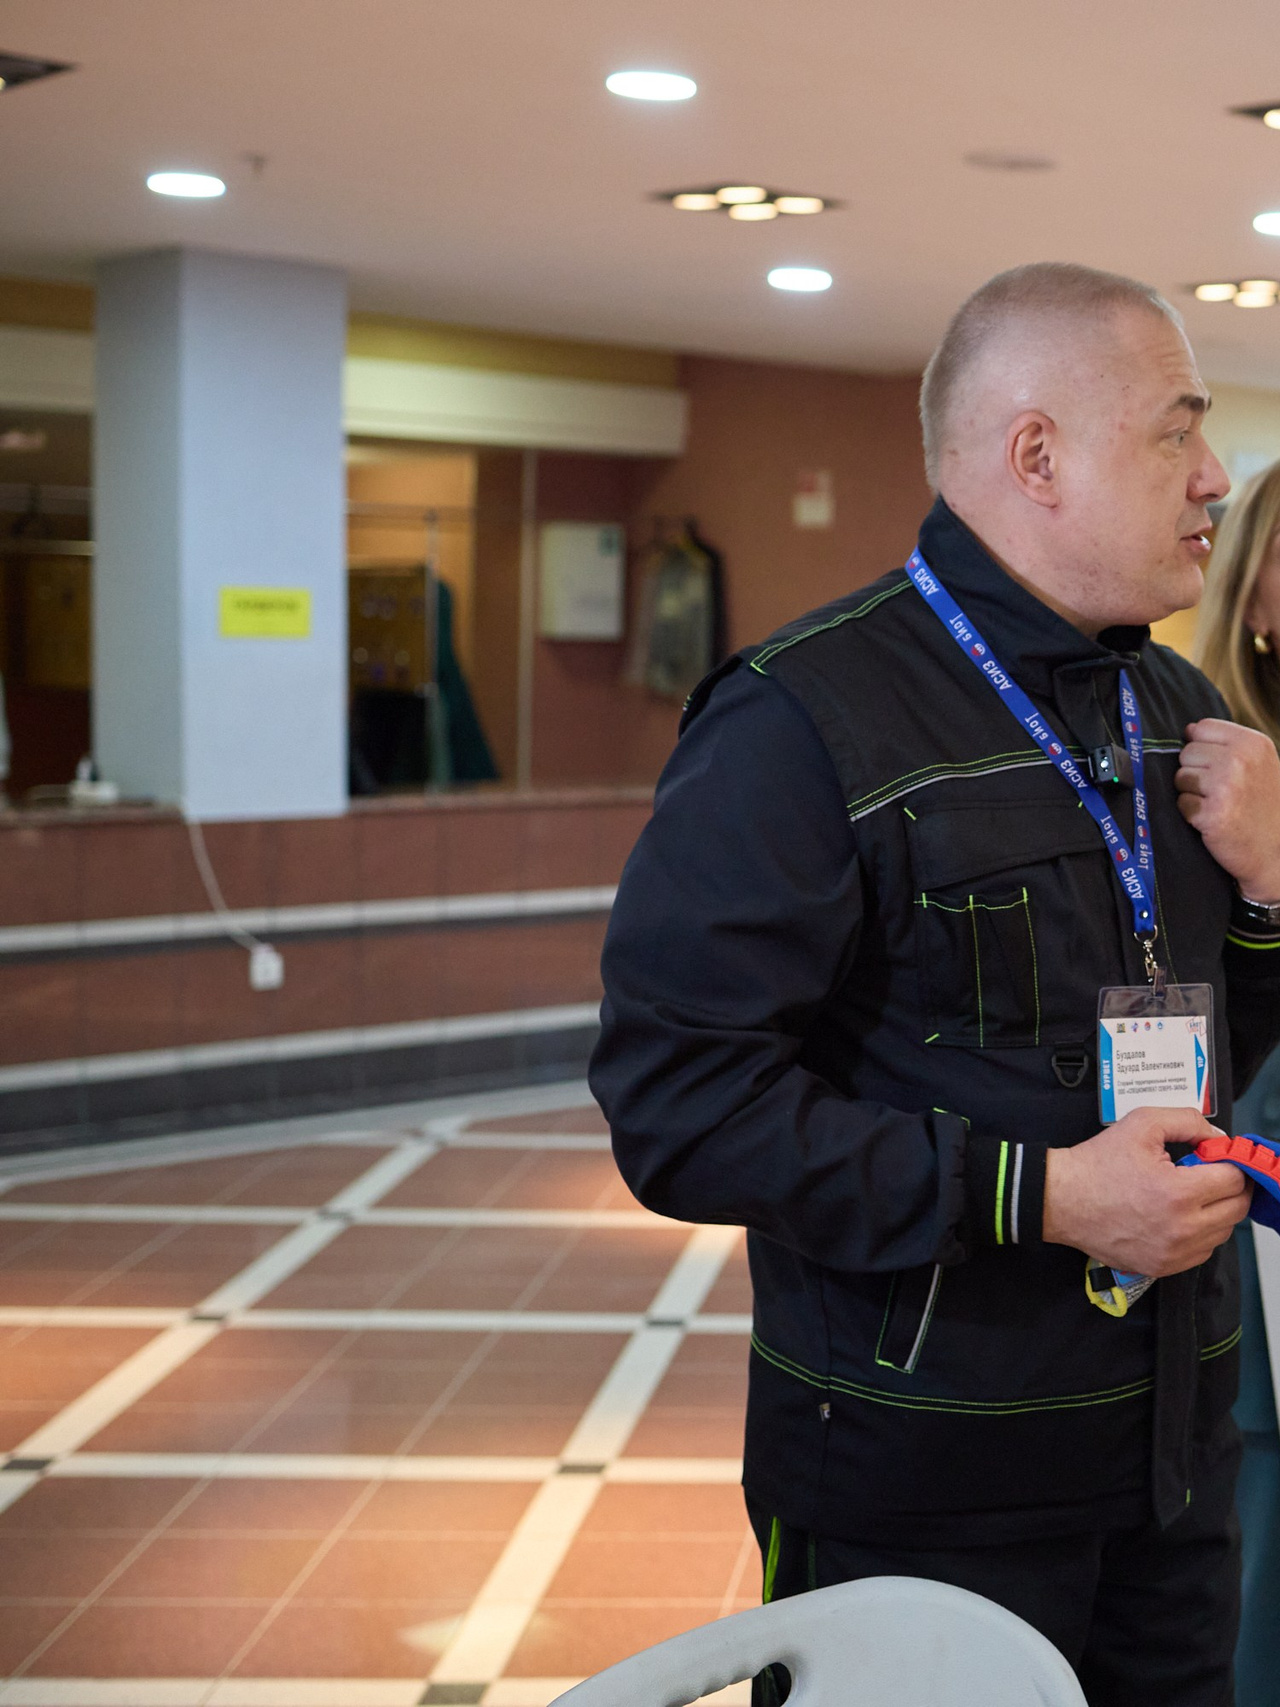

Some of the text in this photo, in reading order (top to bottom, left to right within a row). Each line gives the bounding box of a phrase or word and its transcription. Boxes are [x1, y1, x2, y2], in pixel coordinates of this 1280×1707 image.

[914, 568, 939, 595] АСИЗ
[982, 660, 1012, 690] АСИЗ
[1122, 688, 1136, 717] АСИЗ
[1061, 760, 1088, 788] АСИЗ
[1135, 788, 1147, 820] АСИЗ
[1121, 867, 1144, 899] АСИЗ
[1117, 1061, 1185, 1074] Эдуард Валентинович
